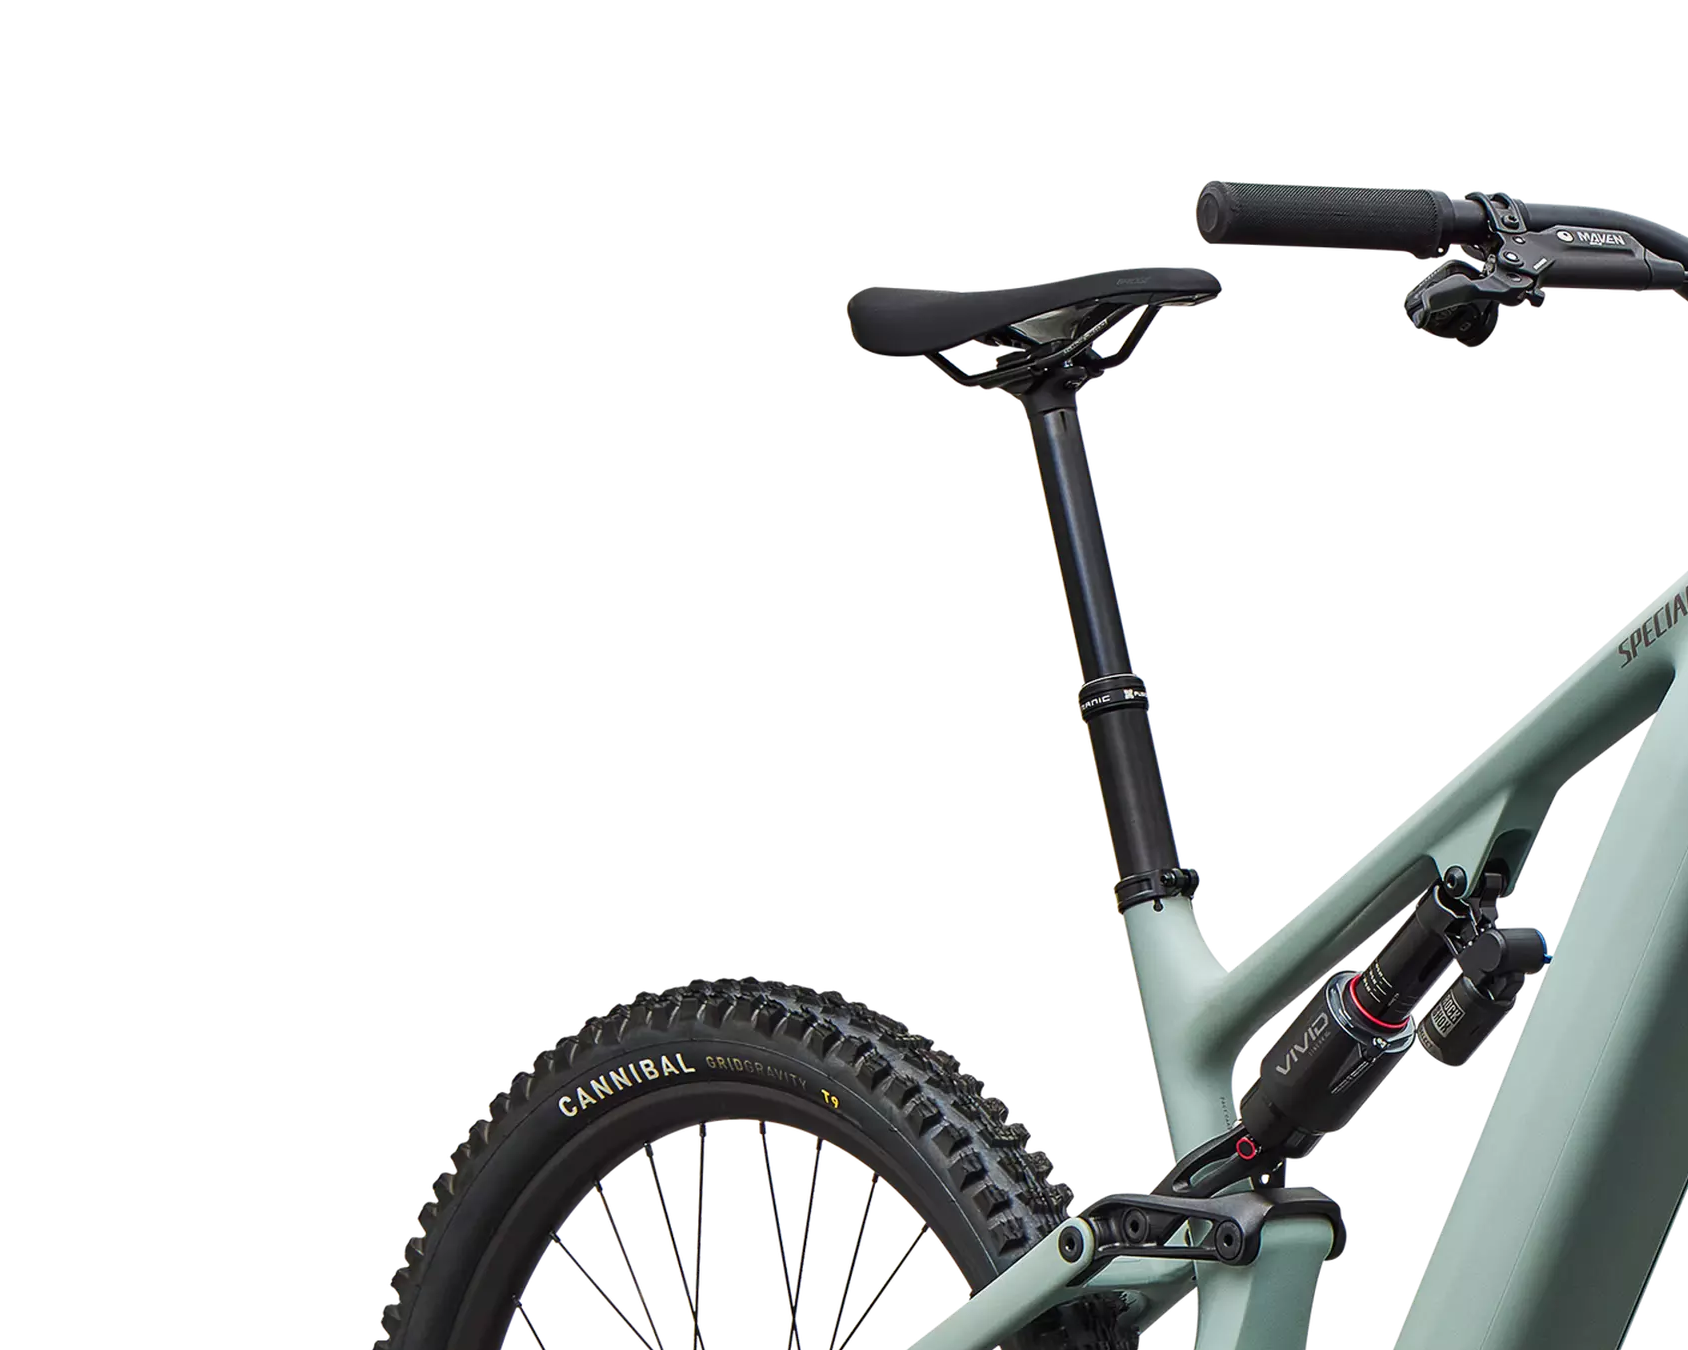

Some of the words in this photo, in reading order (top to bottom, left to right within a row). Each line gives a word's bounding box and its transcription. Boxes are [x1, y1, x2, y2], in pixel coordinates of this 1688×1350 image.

[1577, 230, 1626, 245] MAVEN
[1275, 1012, 1329, 1075] VIVID
[558, 1052, 697, 1117] CANNIBAL
[705, 1056, 808, 1091] GRIDGRAVITY
[820, 1088, 841, 1109] T9
